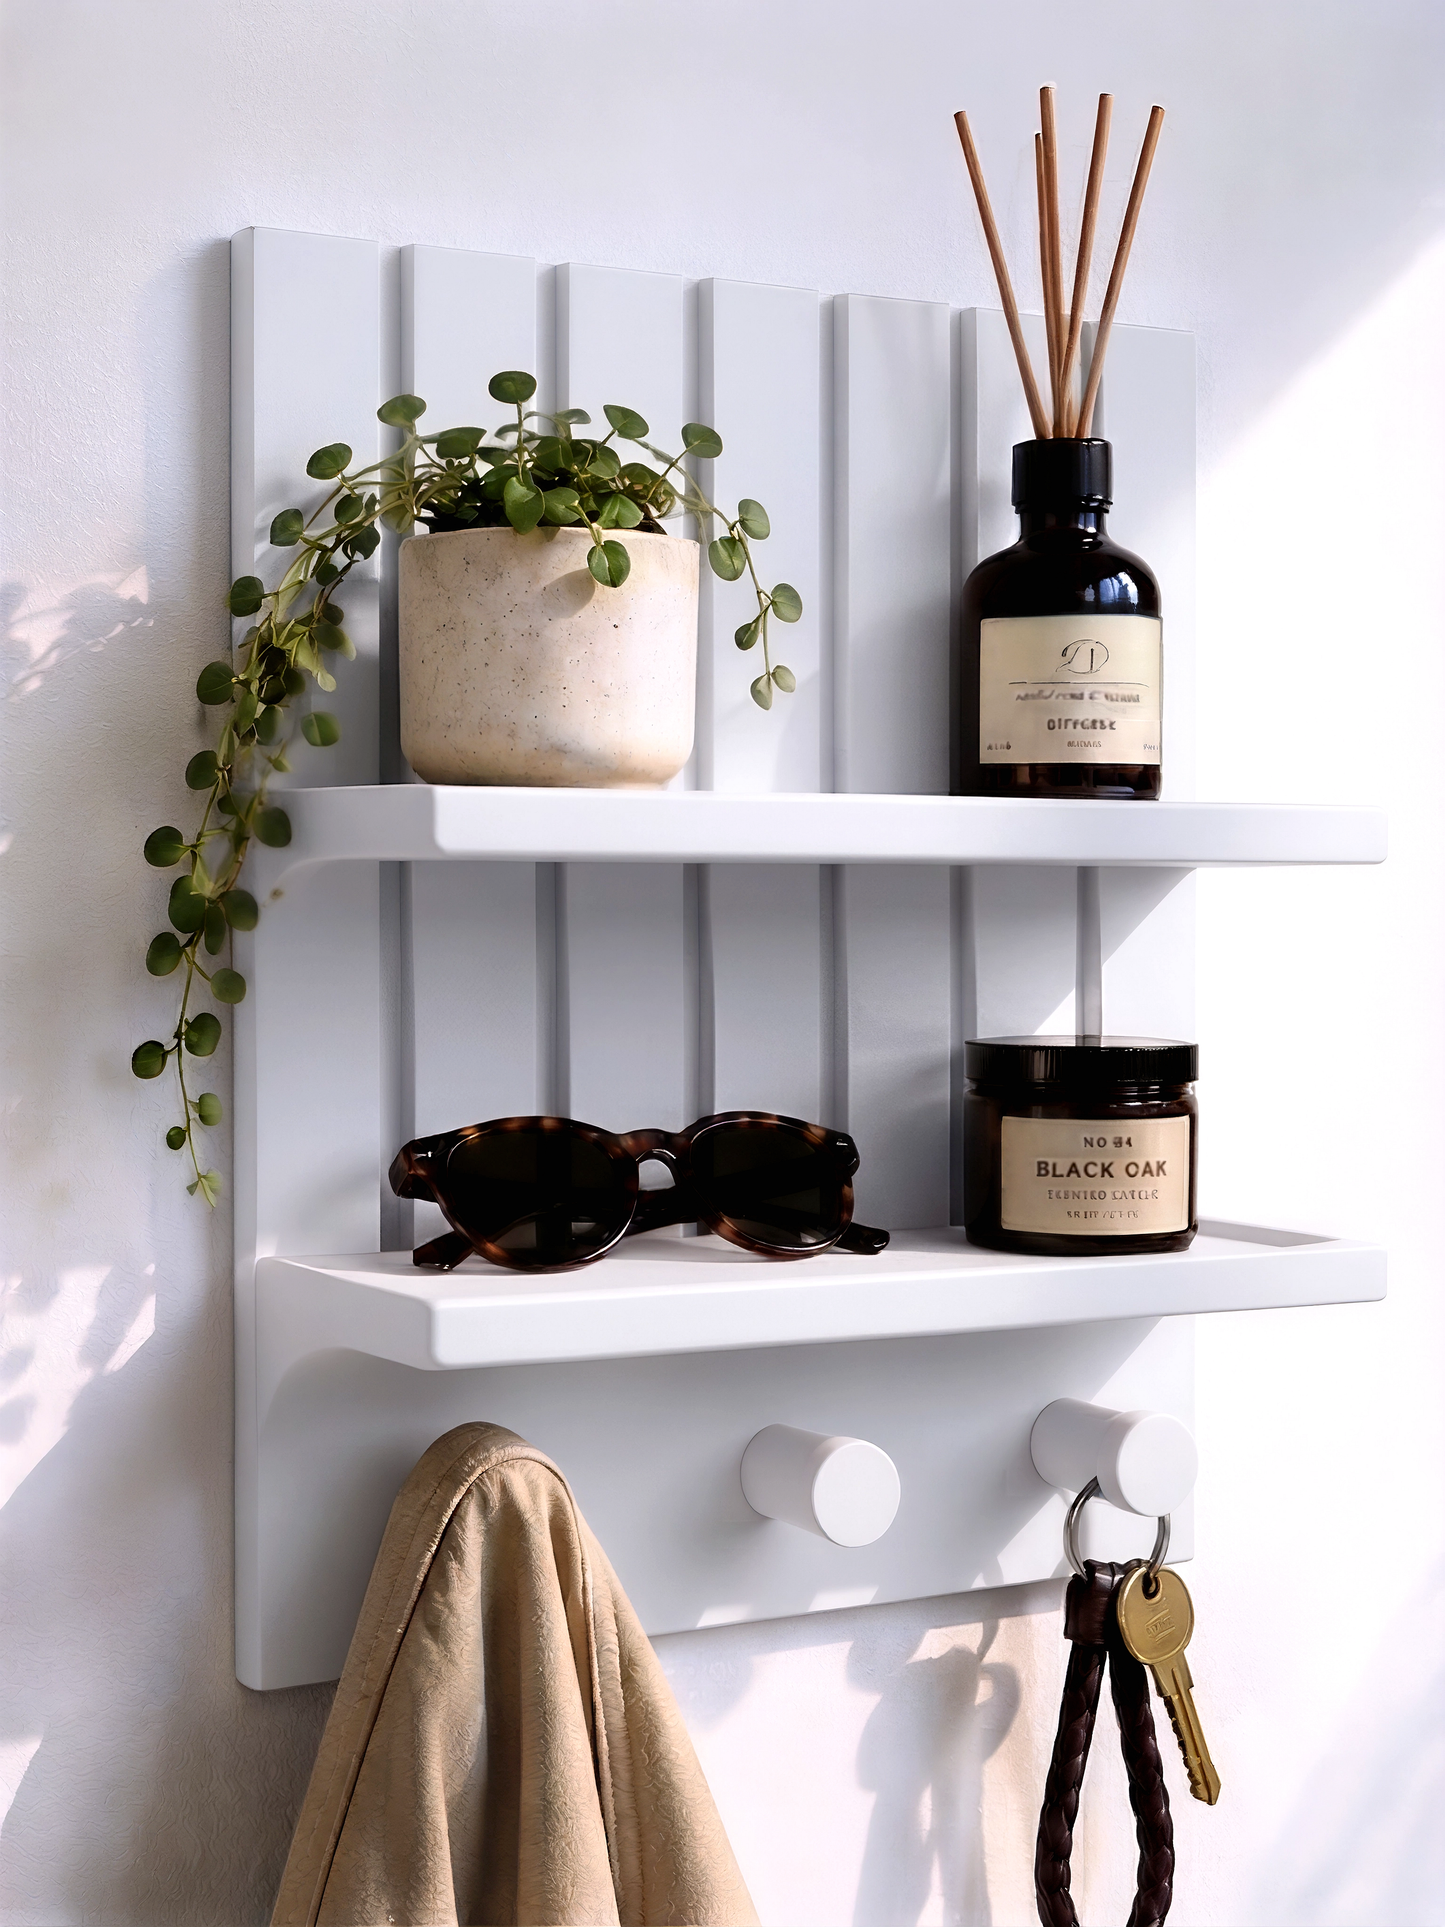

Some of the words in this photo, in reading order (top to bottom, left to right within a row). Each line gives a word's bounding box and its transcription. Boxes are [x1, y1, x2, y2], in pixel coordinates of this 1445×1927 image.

[1083, 1136, 1107, 1148] NO
[1036, 1160, 1115, 1178] BLACK
[1125, 1160, 1167, 1178] OAK
